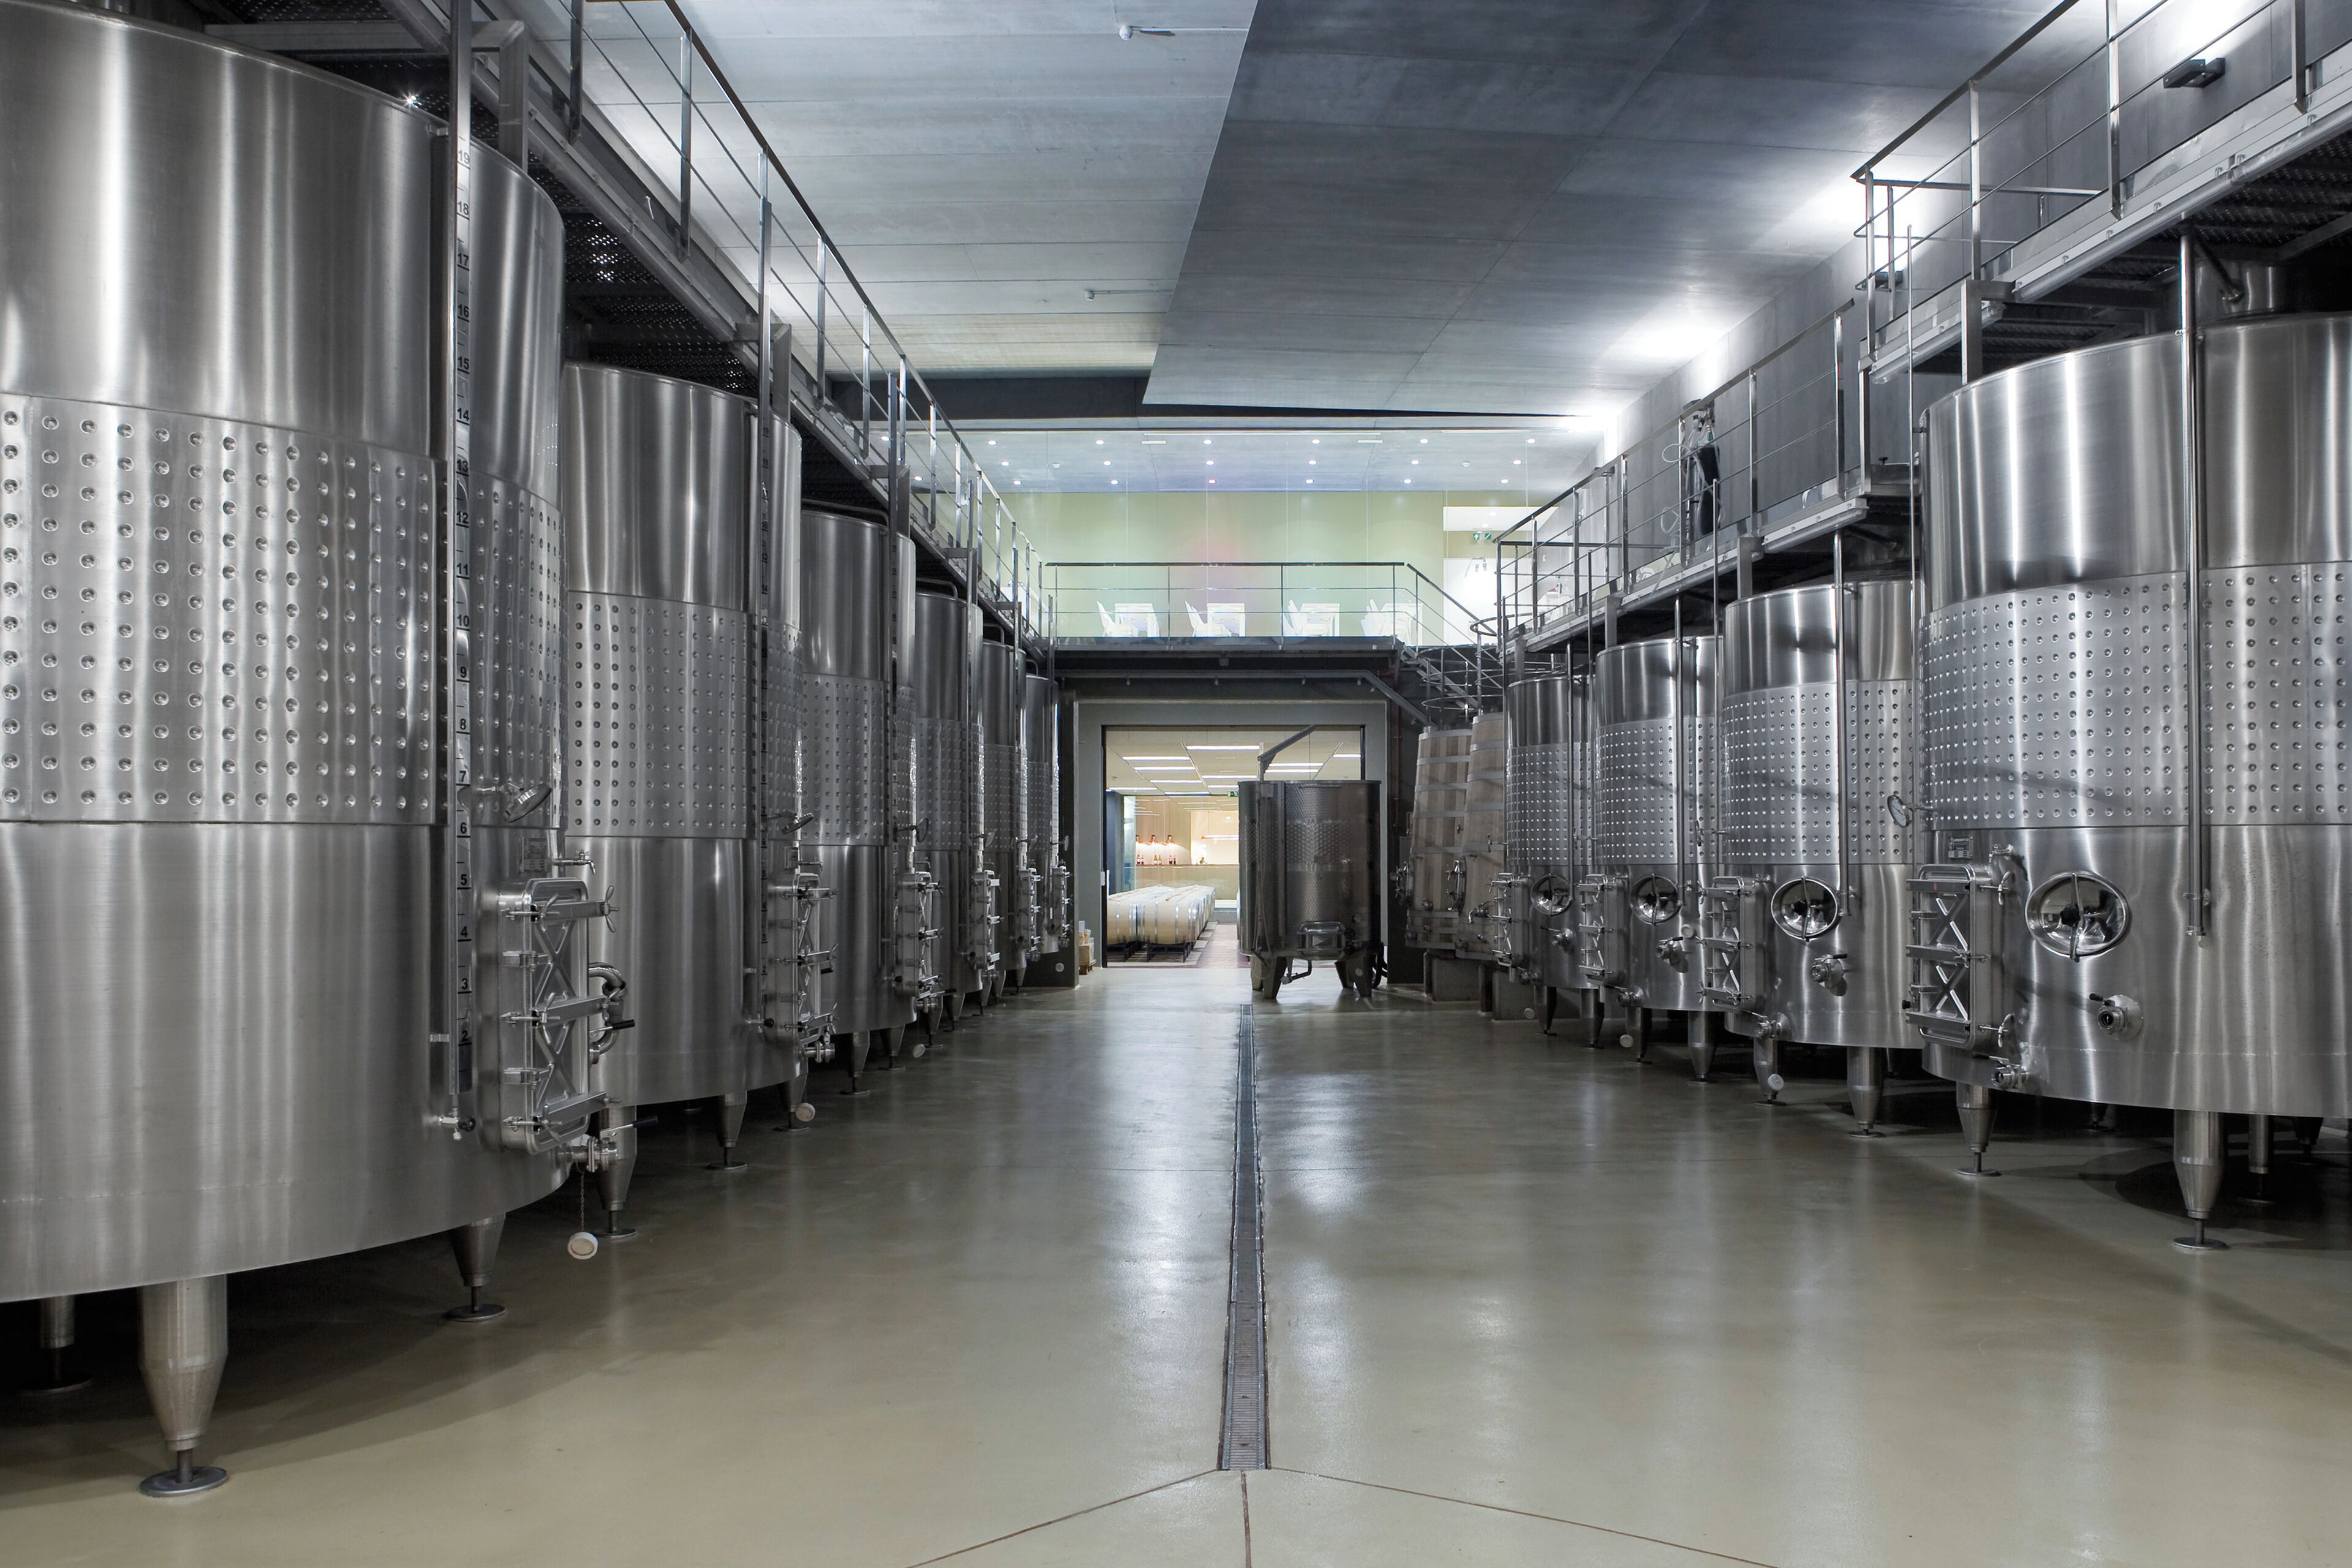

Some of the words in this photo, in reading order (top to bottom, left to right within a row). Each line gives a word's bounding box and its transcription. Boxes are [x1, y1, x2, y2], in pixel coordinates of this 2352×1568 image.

[458, 149, 470, 165] 19
[458, 201, 469, 215] 18
[458, 252, 469, 266] 17
[458, 304, 469, 318] 16
[458, 356, 469, 370] 15
[457, 407, 469, 421] 14
[457, 459, 469, 472] 13
[456, 511, 469, 524] 12
[457, 563, 468, 576] 11
[457, 614, 470, 627] 10
[460, 666, 467, 678] 9
[460, 718, 466, 730] 8
[460, 770, 466, 782] 7
[460, 822, 467, 834] 6
[461, 874, 467, 886] 5
[461, 926, 468, 938] 4
[461, 978, 468, 990] 3
[461, 1030, 469, 1041] 2
